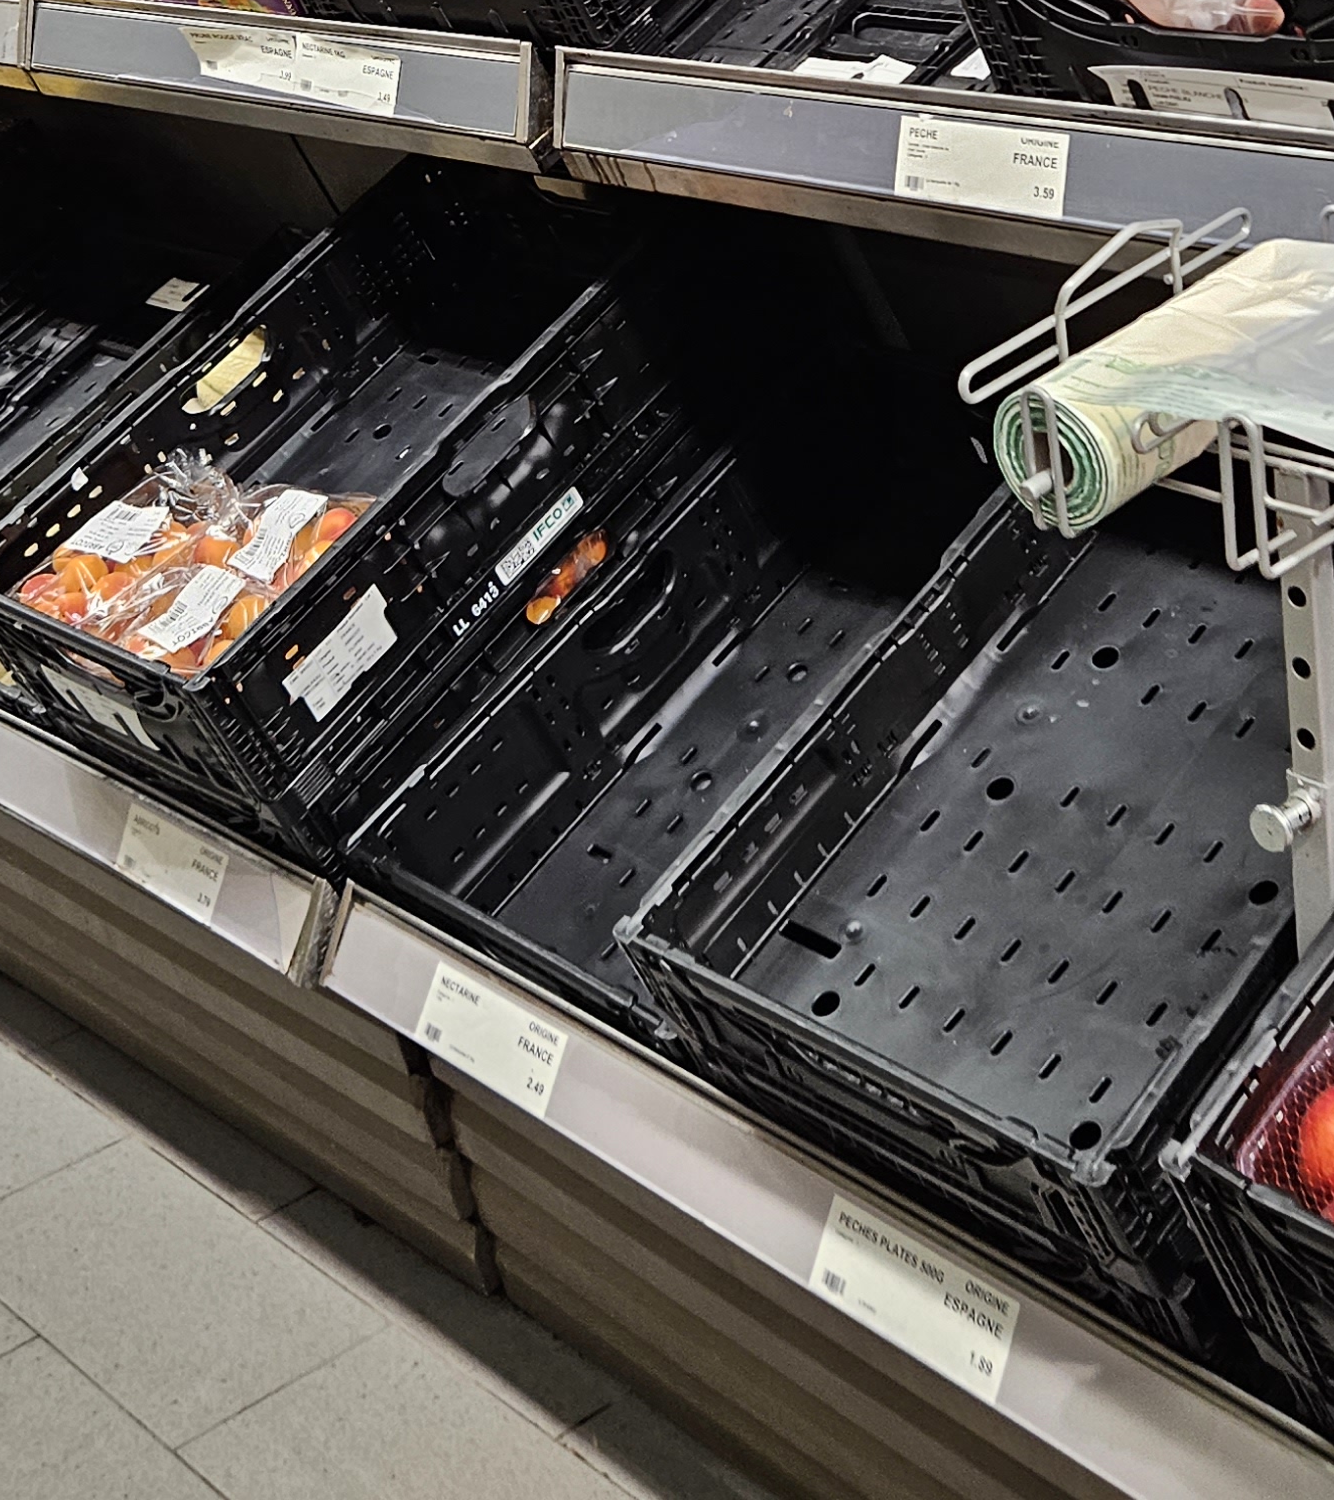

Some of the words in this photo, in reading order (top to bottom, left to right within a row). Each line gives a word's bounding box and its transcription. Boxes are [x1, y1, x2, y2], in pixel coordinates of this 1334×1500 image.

[260, 45, 293, 60] ESPAGNE
[301, 41, 334, 56] NECTARINE
[361, 64, 395, 80] ESPAGNE
[908, 126, 939, 140] PECHE
[1012, 152, 1058, 170] FRANCE
[1033, 185, 1055, 200] 3.59
[532, 507, 563, 542] IFCO
[452, 617, 471, 637] LL
[470, 583, 500, 617] 6413
[172, 615, 216, 648] ABRICOT
[191, 858, 219, 883] FRANCE
[441, 975, 481, 1007] NECTARINE
[528, 1020, 560, 1047] ORIGINE
[517, 1036, 555, 1067] FRANCE
[526, 1076, 545, 1096] 2.49
[838, 1210, 879, 1244] PECHES
[879, 1235, 918, 1269] PLATES
[964, 1279, 1011, 1317] ORIGINE
[943, 1291, 1005, 1341] ESPAGNE
